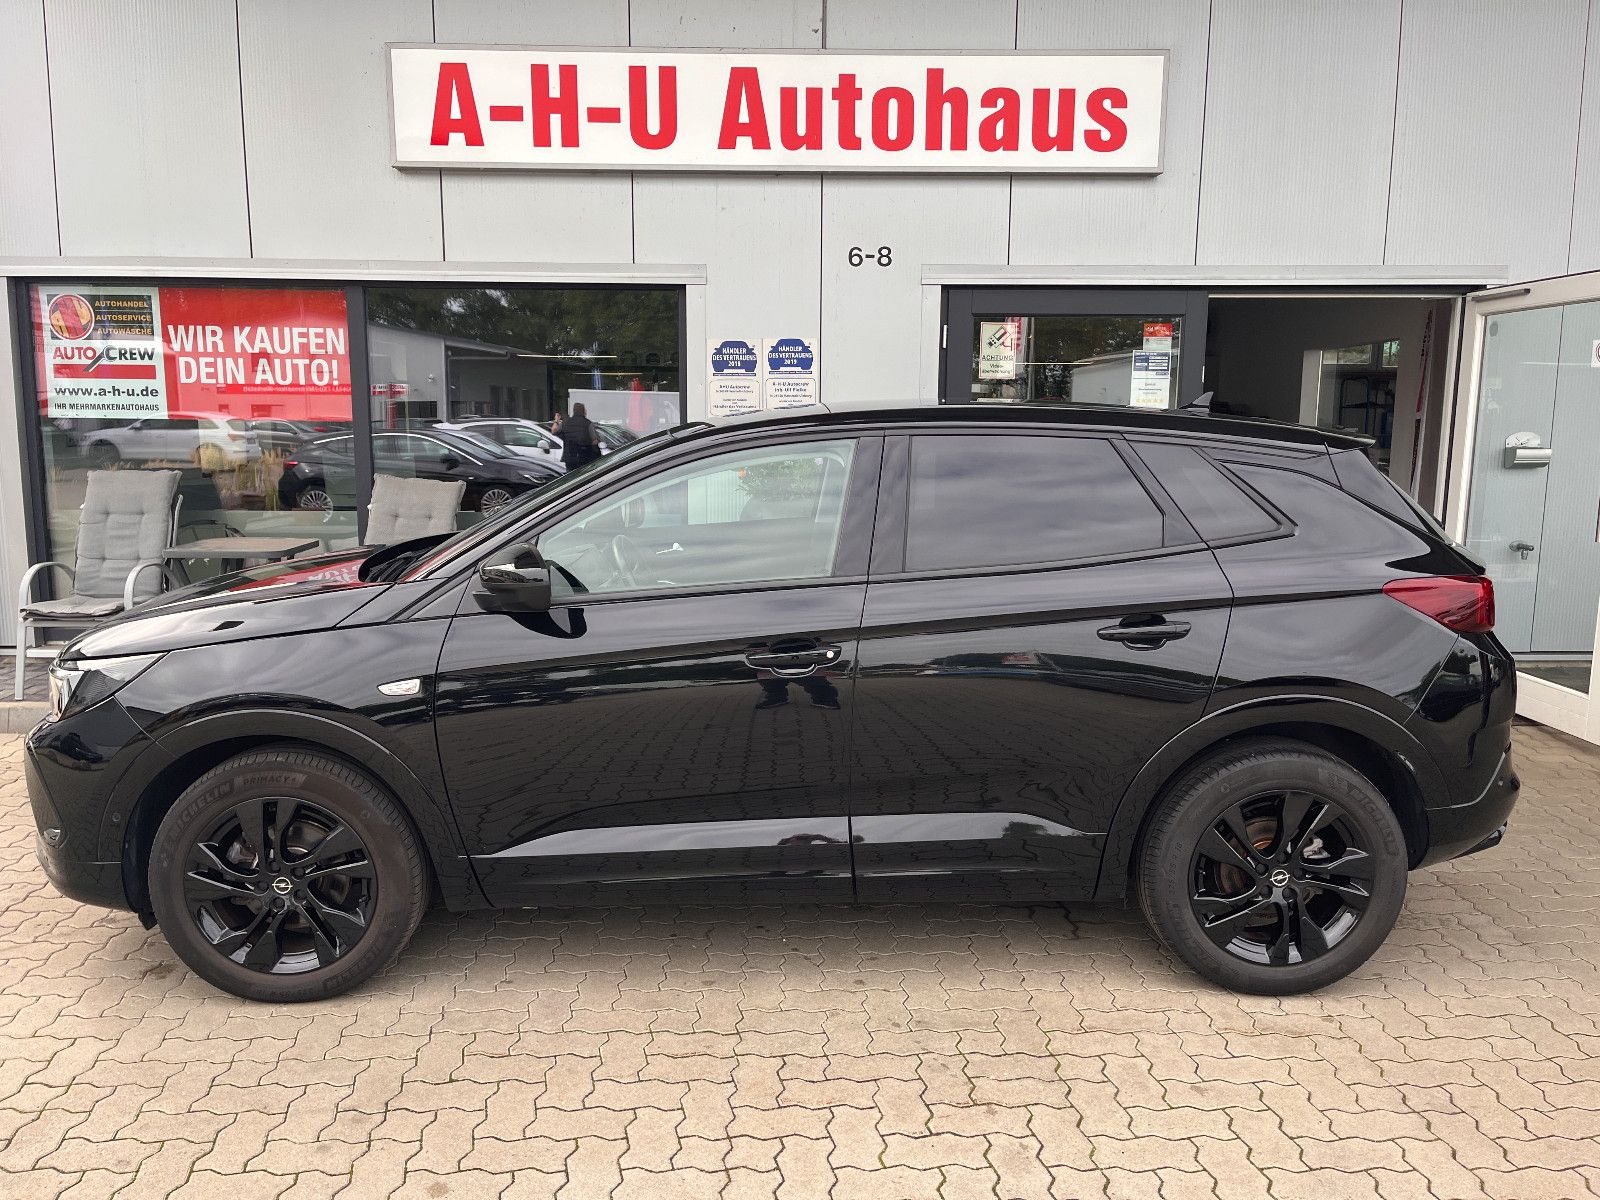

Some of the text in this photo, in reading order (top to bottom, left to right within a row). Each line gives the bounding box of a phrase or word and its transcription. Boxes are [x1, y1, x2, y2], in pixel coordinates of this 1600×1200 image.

[430, 63, 1128, 152] A-H-U Autohaus
[849, 247, 892, 267] 6-8
[95, 300, 148, 308] AUTOHANDEL
[168, 325, 345, 355] WIR KAUFEN
[53, 346, 155, 361] AUTO CREW
[179, 357, 339, 386] DEIN AUTO!
[55, 386, 159, 397] www.a-h-u.de
[69, 403, 159, 411] MEHRMARKENAUTOHAUS
[243, 774, 290, 785] PRIMACY
